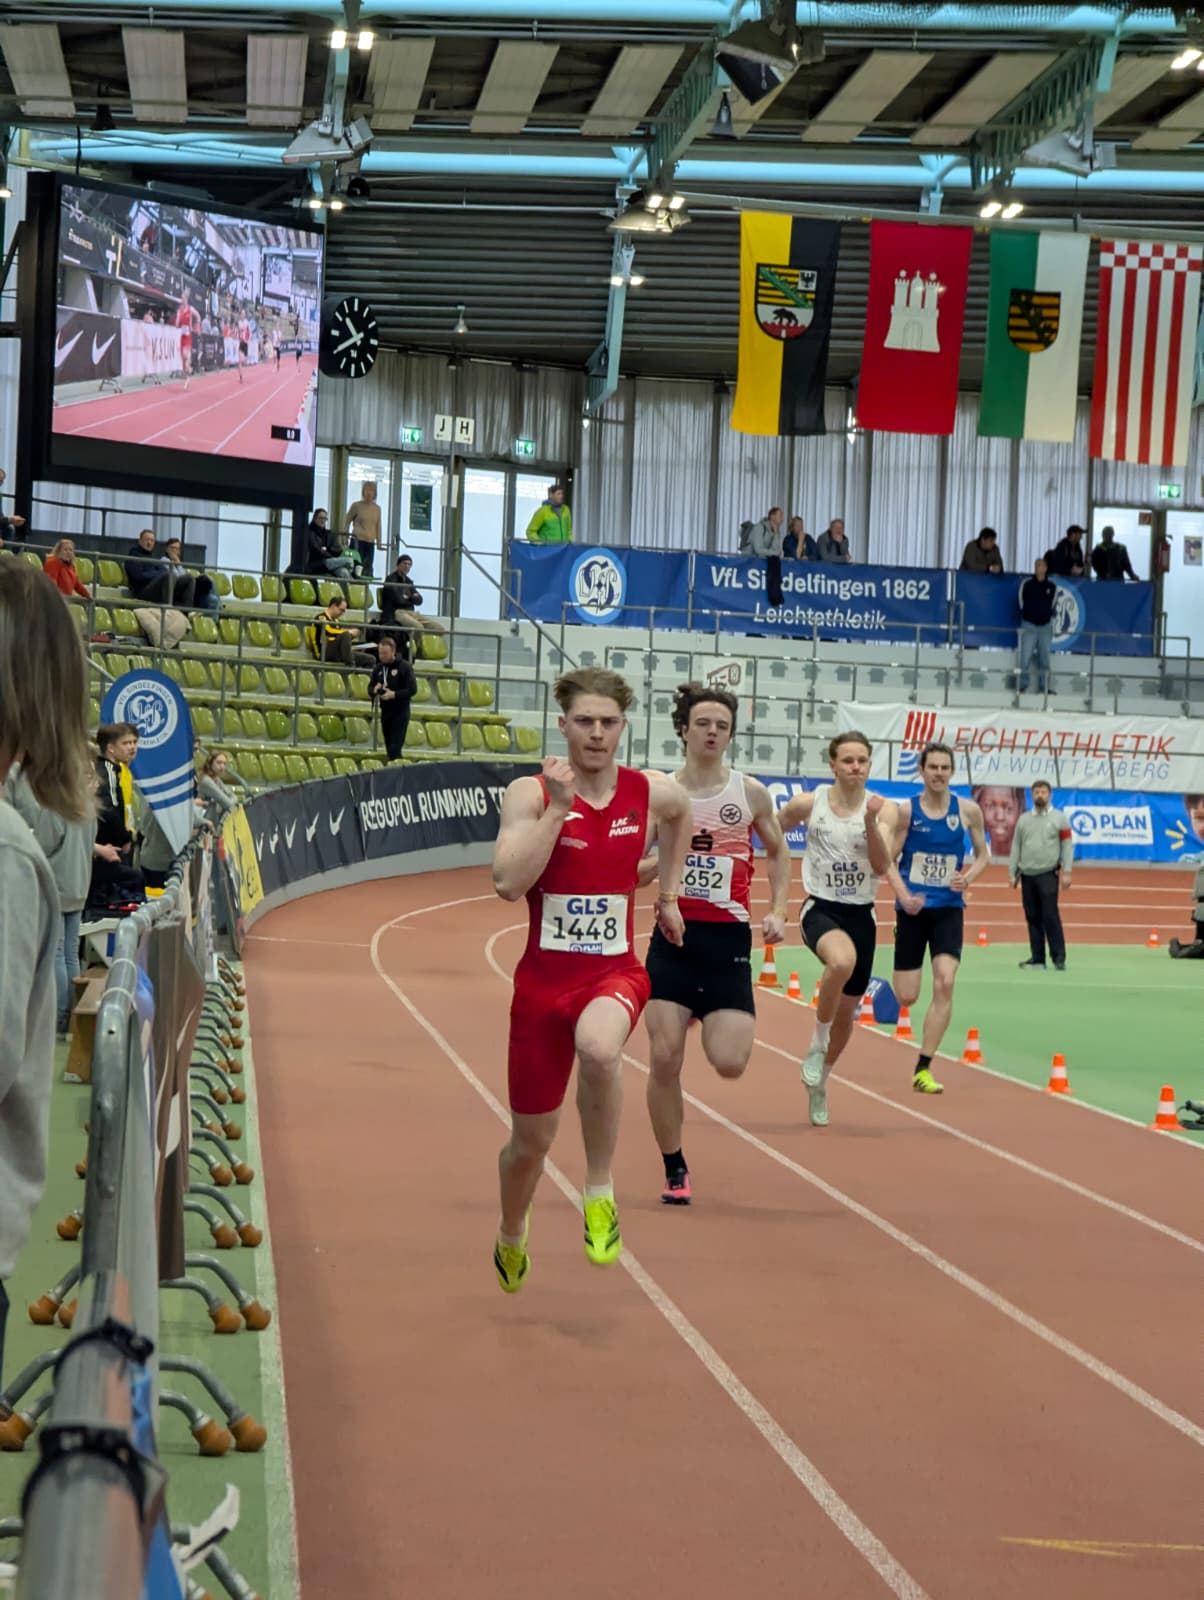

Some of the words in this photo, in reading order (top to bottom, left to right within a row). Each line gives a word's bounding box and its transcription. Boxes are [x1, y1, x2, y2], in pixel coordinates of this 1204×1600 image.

[440, 418, 446, 432] J
[460, 420, 470, 435] H
[711, 566, 743, 589] VfL
[747, 568, 877, 601] Sidelfingen
[882, 578, 931, 600] 1862
[753, 602, 886, 630] Leichtathletik
[360, 794, 420, 832] REGUPOL
[418, 786, 488, 822] RUNNING
[611, 816, 628, 828] LAC
[1100, 814, 1148, 830] PLAN
[784, 829, 804, 842] rcels
[684, 854, 717, 870] GLS
[831, 861, 859, 873] GLS
[925, 855, 947, 865] GLS
[681, 869, 723, 889] 652
[921, 864, 947, 879] 320
[825, 872, 865, 888] 1589
[567, 897, 609, 915] GLS
[552, 916, 617, 941] 1448
